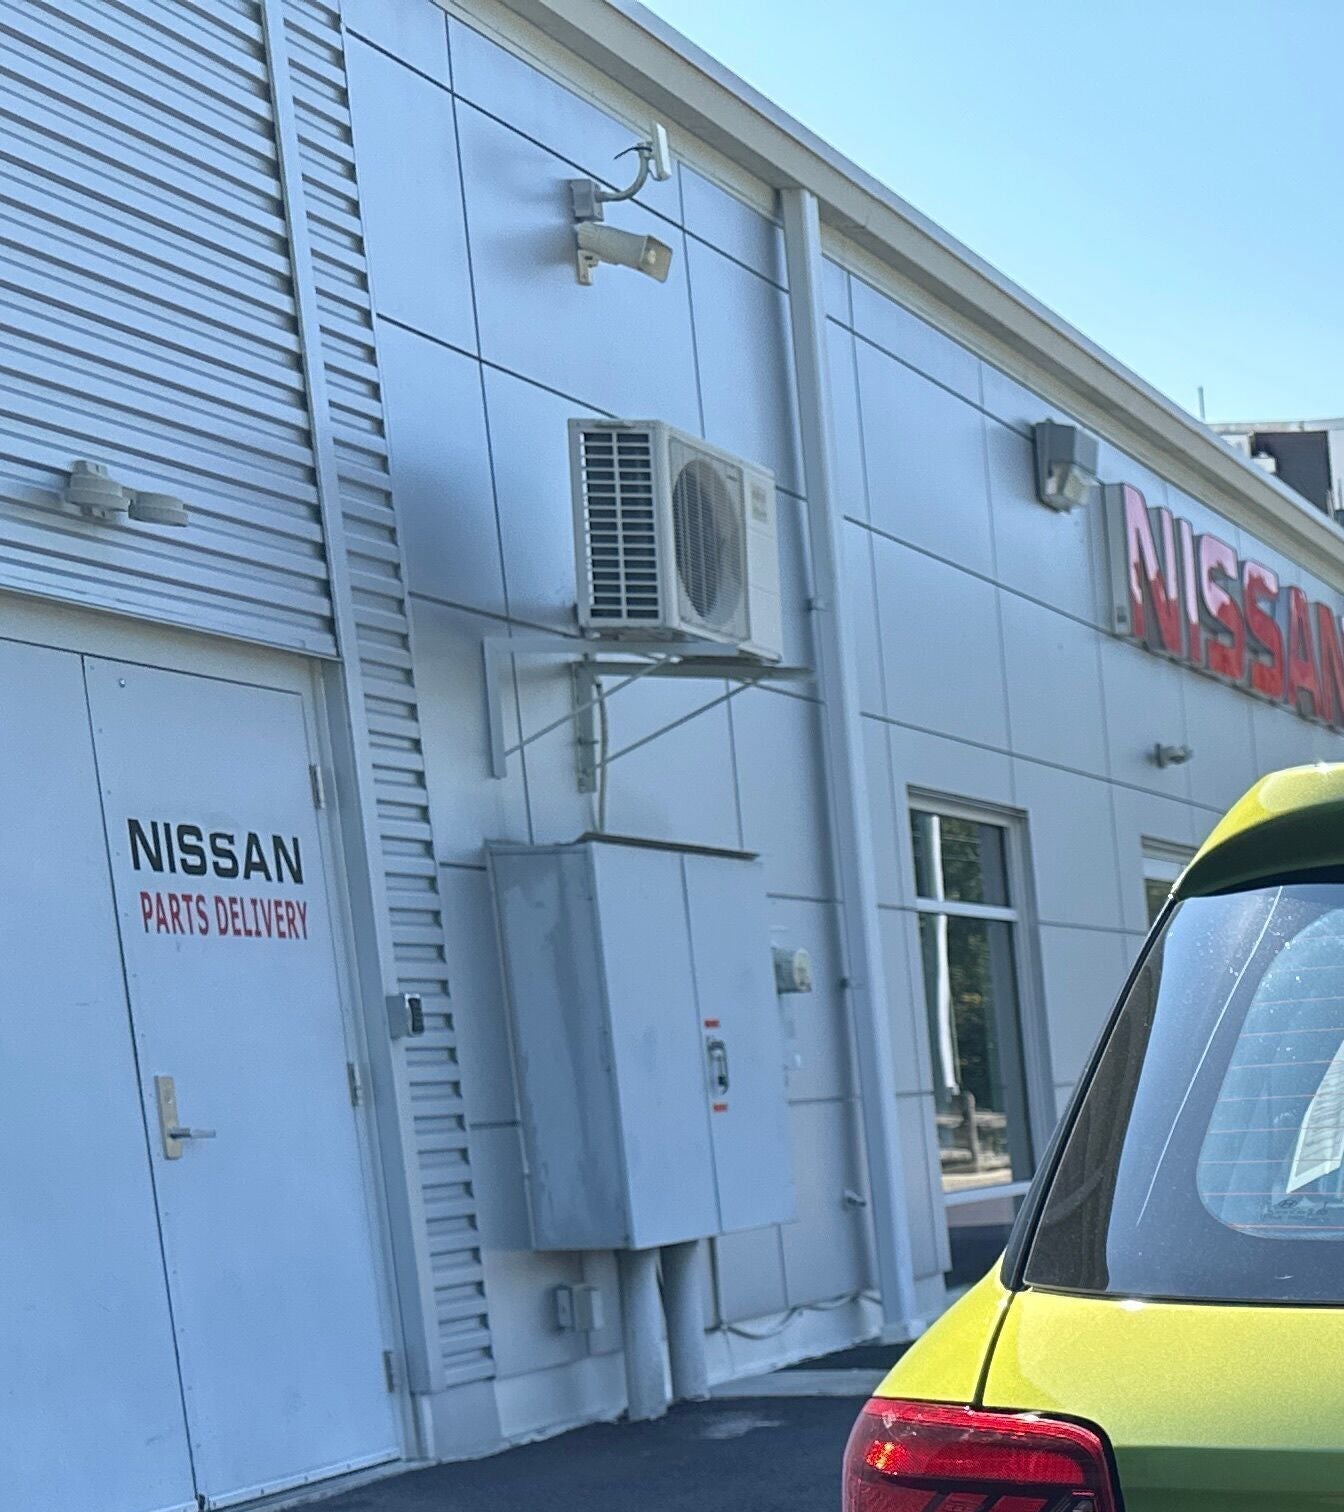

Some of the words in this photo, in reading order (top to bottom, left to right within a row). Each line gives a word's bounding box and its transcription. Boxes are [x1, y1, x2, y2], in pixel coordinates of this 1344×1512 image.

[127, 818, 304, 885] NISSAN
[140, 891, 210, 936] PARTS
[214, 895, 308, 940] DELIVERY
